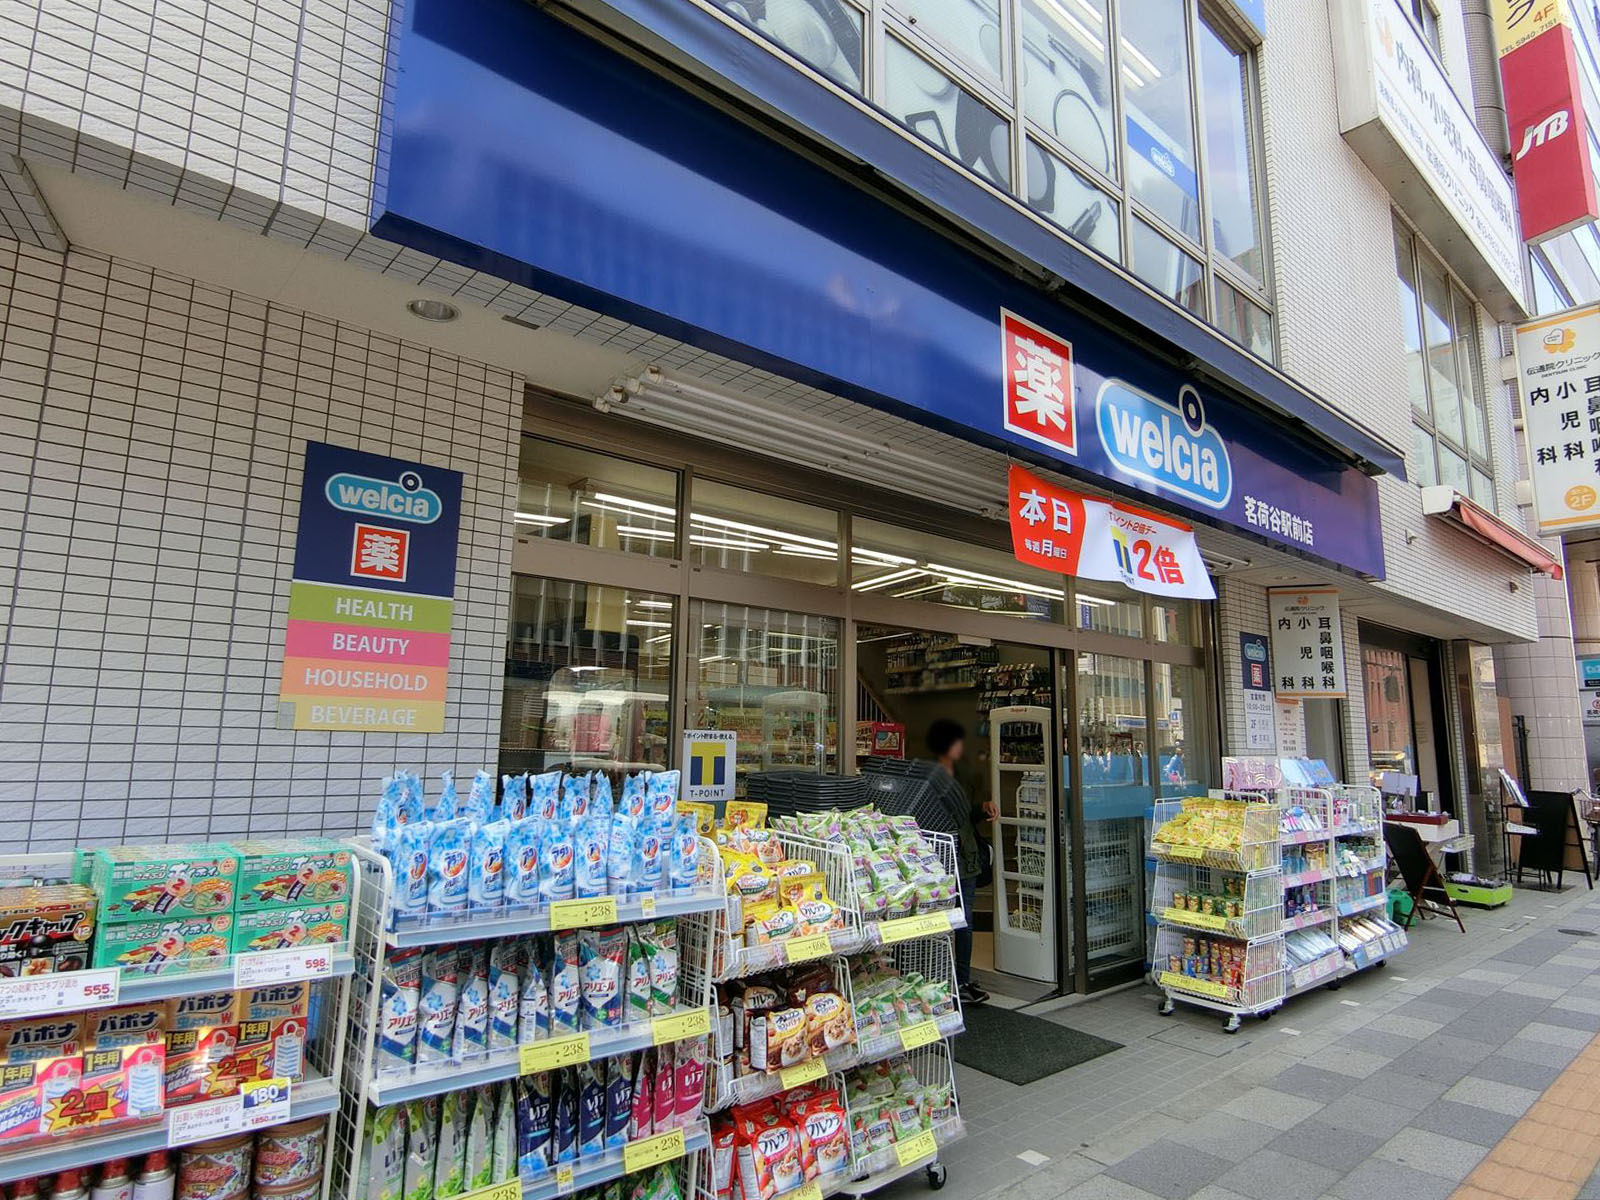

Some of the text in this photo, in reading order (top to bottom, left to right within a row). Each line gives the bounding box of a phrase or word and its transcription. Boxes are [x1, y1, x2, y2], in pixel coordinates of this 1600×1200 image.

[1533, 2, 1555, 23] 4F
[1515, 110, 1569, 161] JTB
[1014, 335, 1068, 432] 薬
[1108, 402, 1220, 494] welcia
[337, 483, 430, 519] welcia
[1018, 489, 1072, 535] 本日
[1243, 495, 1314, 547] 茗荷谷駅前店
[361, 533, 400, 573] 薬
[1024, 538, 1067, 560] 毎週月曜日
[1132, 539, 1185, 585] 2倍
[335, 597, 414, 622] HEALTH
[332, 632, 410, 656] BEAUTY
[1318, 617, 1336, 690] 耳鼻咽喉科
[303, 668, 428, 692] HOUSEHOLD
[310, 705, 417, 726] BEVERAGE
[690, 788, 725, 798] T-POINT
[590, 905, 612, 918] 238
[77, 927, 91, 936] 12
[305, 958, 326, 969] 598
[83, 983, 110, 997] 555
[251, 986, 303, 1004] バポナ
[583, 979, 616, 993] アリエール
[178, 993, 233, 1013] バポナ
[98, 1011, 158, 1032] バポナ
[240, 1021, 269, 1040] 1年用
[687, 1014, 706, 1029] 238
[10, 1022, 77, 1045] バポナ
[562, 1042, 584, 1058] 238
[86, 1051, 119, 1073] 1年用
[59, 1088, 109, 1118] 2個
[250, 1084, 279, 1105] 180
[660, 1135, 681, 1152] 238
[492, 1186, 517, 1200] 238
